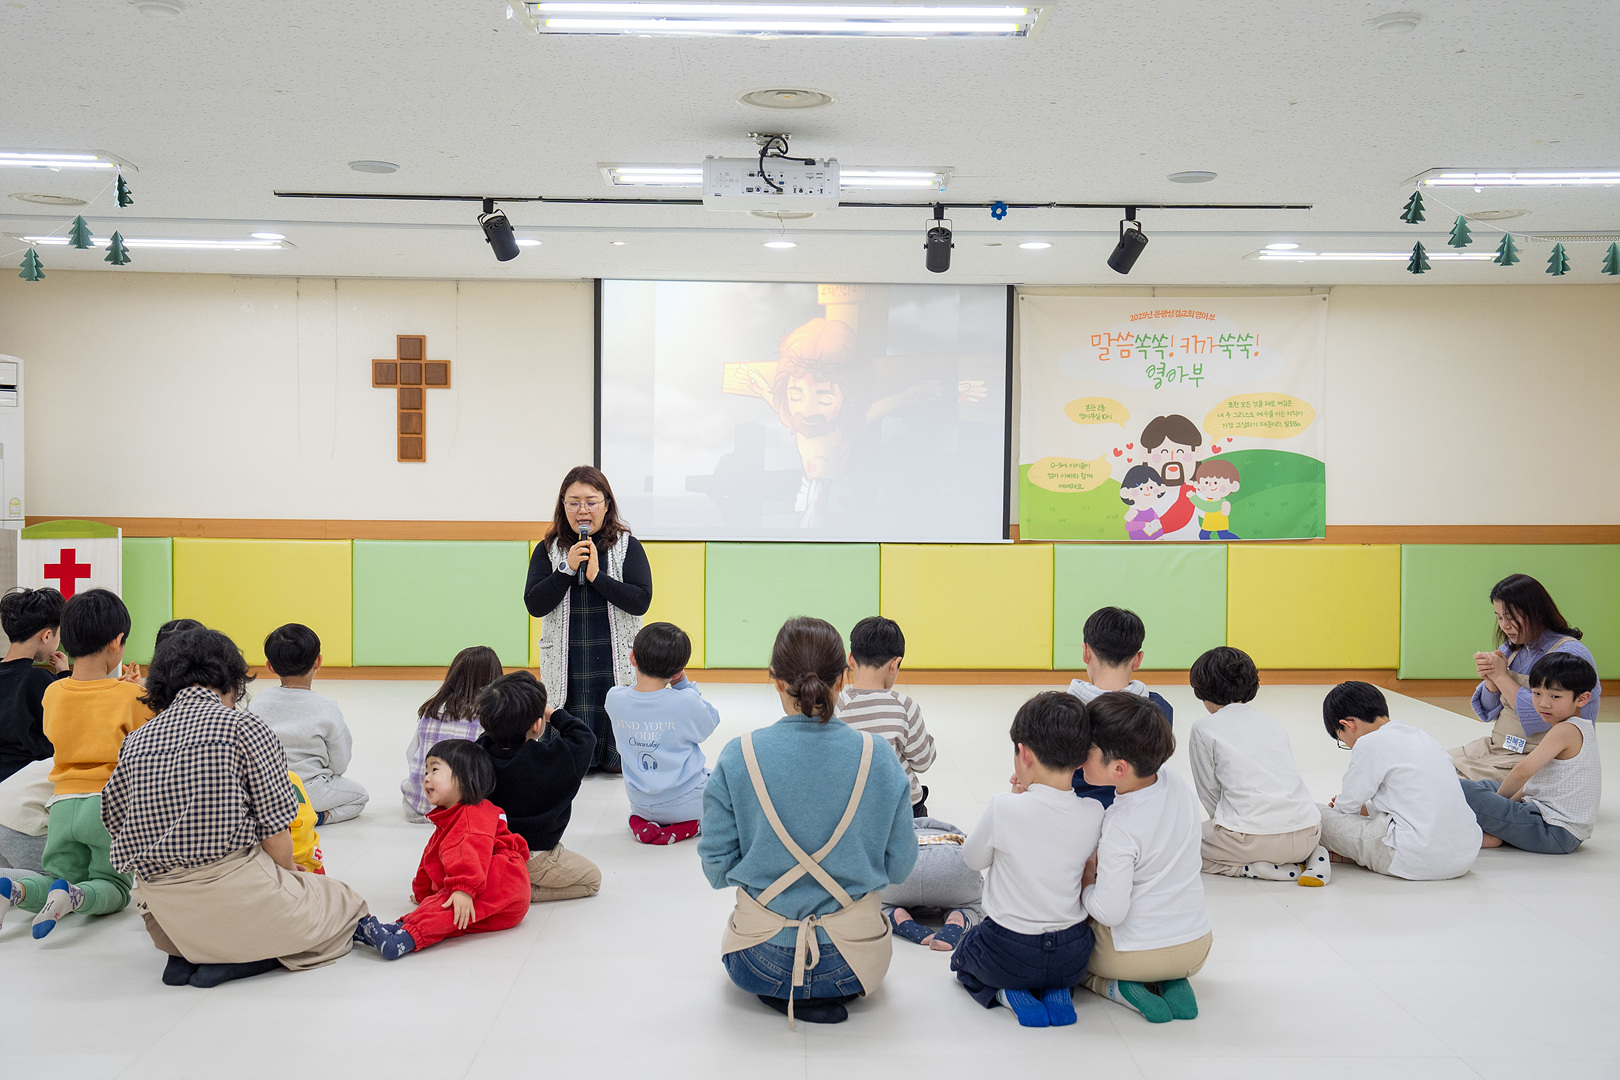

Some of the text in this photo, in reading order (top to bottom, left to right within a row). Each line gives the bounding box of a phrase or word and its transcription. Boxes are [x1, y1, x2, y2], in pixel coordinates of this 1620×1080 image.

[1130, 310, 1153, 321] 2025년
[1091, 331, 1260, 361] 말씀쏙쏙! 키가쑥쑥!
[1146, 362, 1205, 390] 영아부
[1256, 410, 1274, 418] 예수를
[616, 720, 676, 731] FIND YOUR
